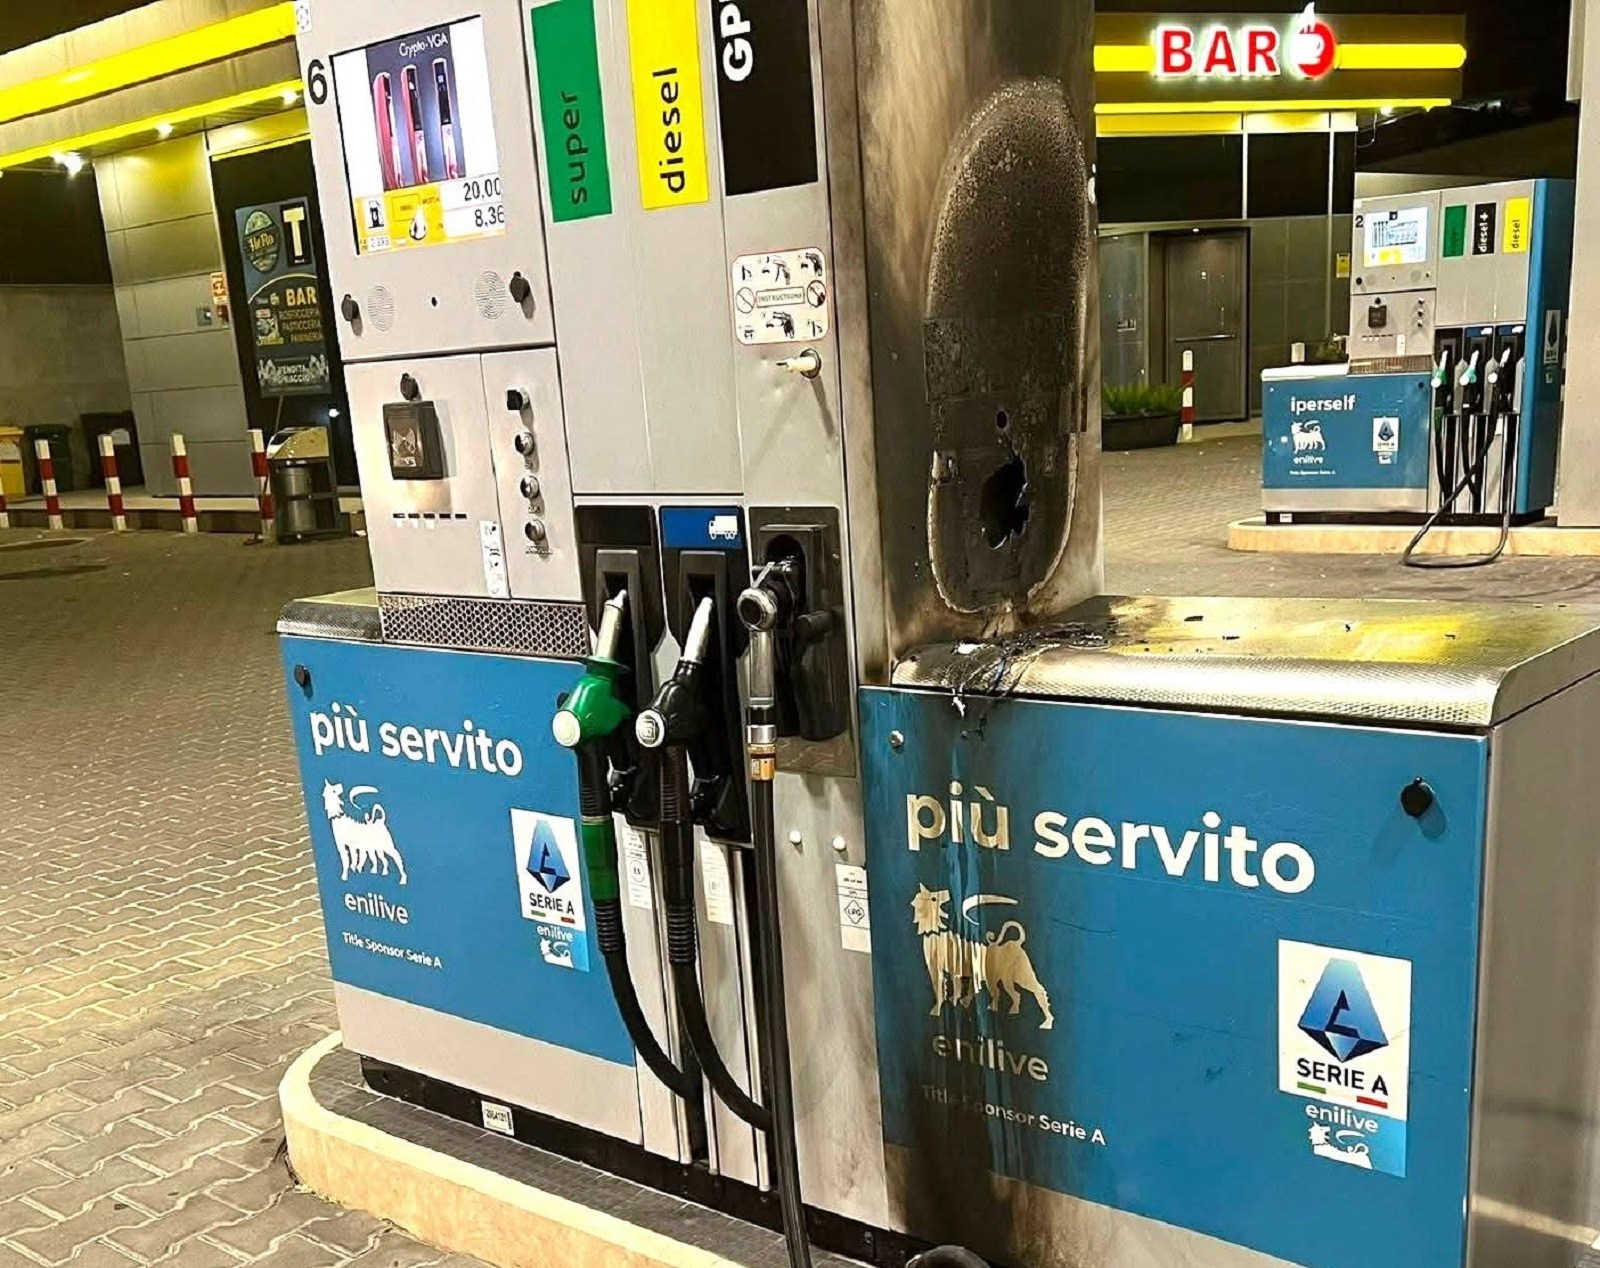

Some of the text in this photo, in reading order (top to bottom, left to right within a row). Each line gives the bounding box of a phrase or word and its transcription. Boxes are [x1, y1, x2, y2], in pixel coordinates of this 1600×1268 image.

[719, 0, 754, 81] GP
[1161, 30, 1278, 73] BAR
[307, 58, 328, 105] 6
[561, 91, 589, 205] super
[652, 67, 685, 193] diesel
[1355, 215, 1364, 228] 2
[1510, 219, 1520, 249] diesel
[286, 286, 317, 307] BAR
[1291, 394, 1356, 415] iperself
[310, 702, 523, 776] più servito
[906, 780, 1316, 894] più servito
[344, 892, 409, 925] enilive
[529, 892, 575, 915] SERIE A
[342, 931, 442, 968] Title Sponsor Serie A
[536, 924, 574, 943] enilive
[933, 1035, 1049, 1081] enilive
[1297, 1057, 1389, 1096] SERIE A
[921, 1084, 957, 1104] Titl
[1039, 1114, 1087, 1140] Serie
[1091, 1129, 1106, 1146] A
[1305, 1103, 1379, 1133] enilive
